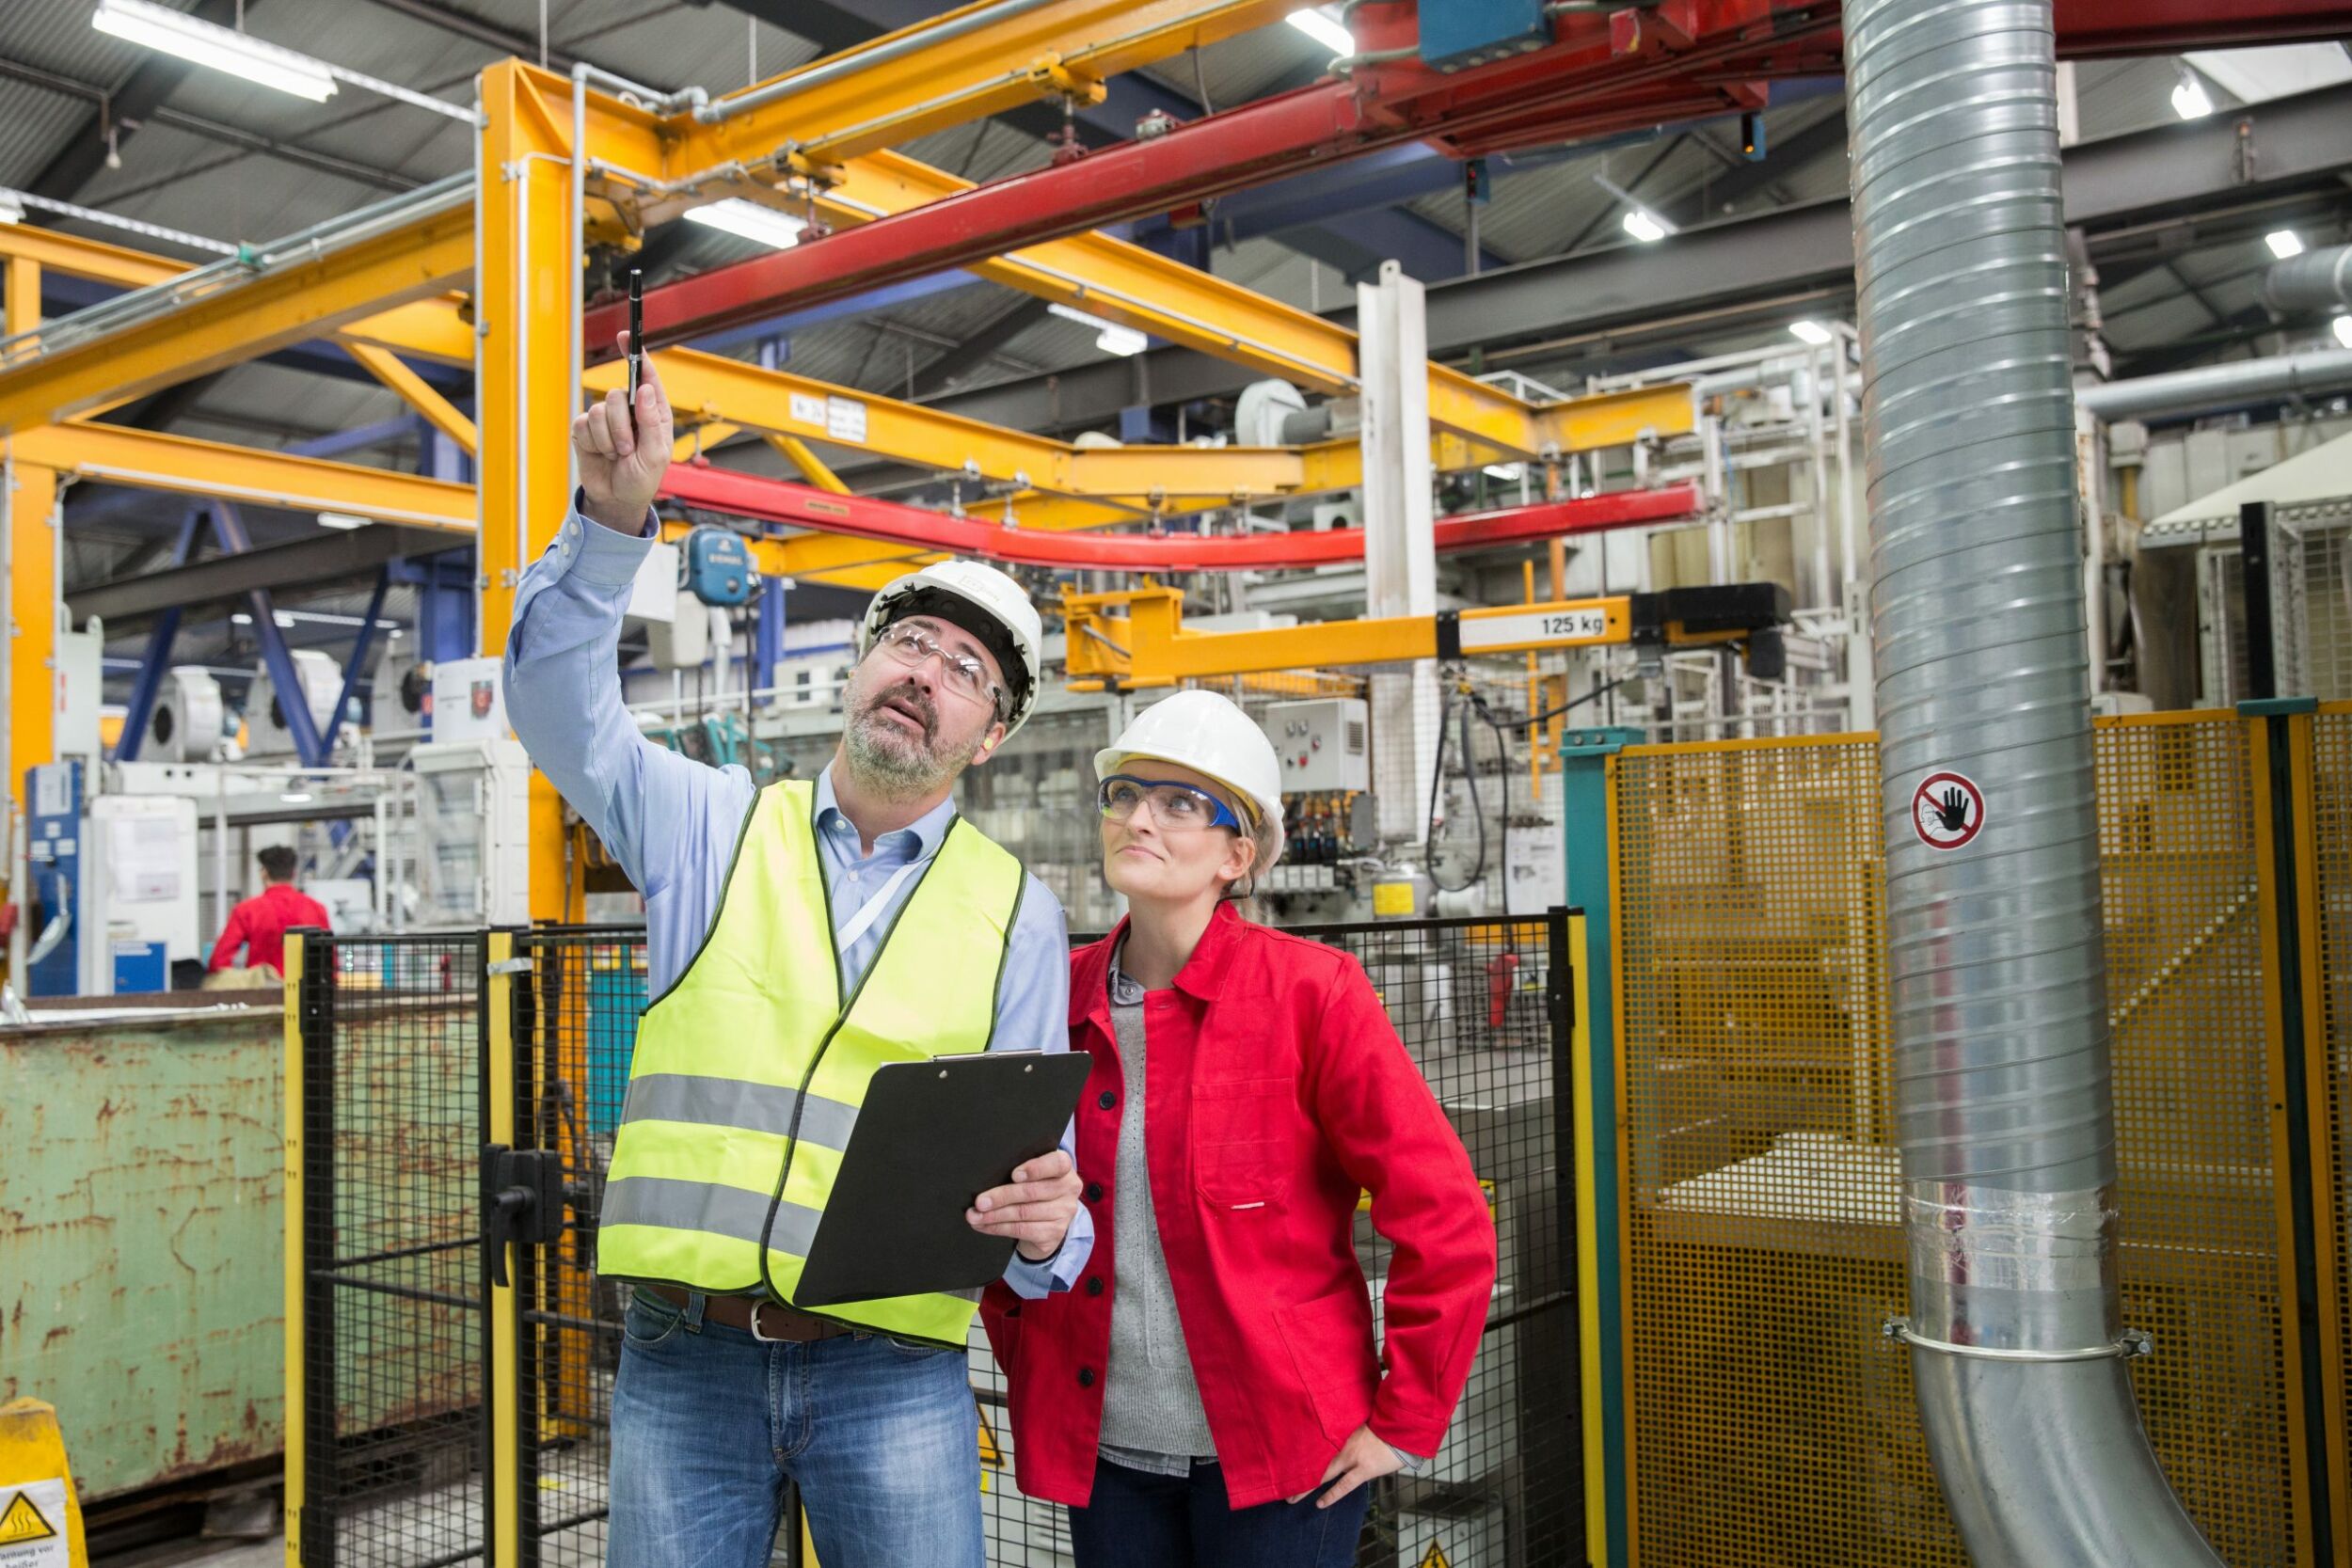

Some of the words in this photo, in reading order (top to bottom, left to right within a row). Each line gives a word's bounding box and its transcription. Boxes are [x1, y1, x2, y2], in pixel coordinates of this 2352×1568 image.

[1543, 616, 1574, 634] 125
[1581, 615, 1602, 635] kg
[0, 1548, 36, 1560] arnung
